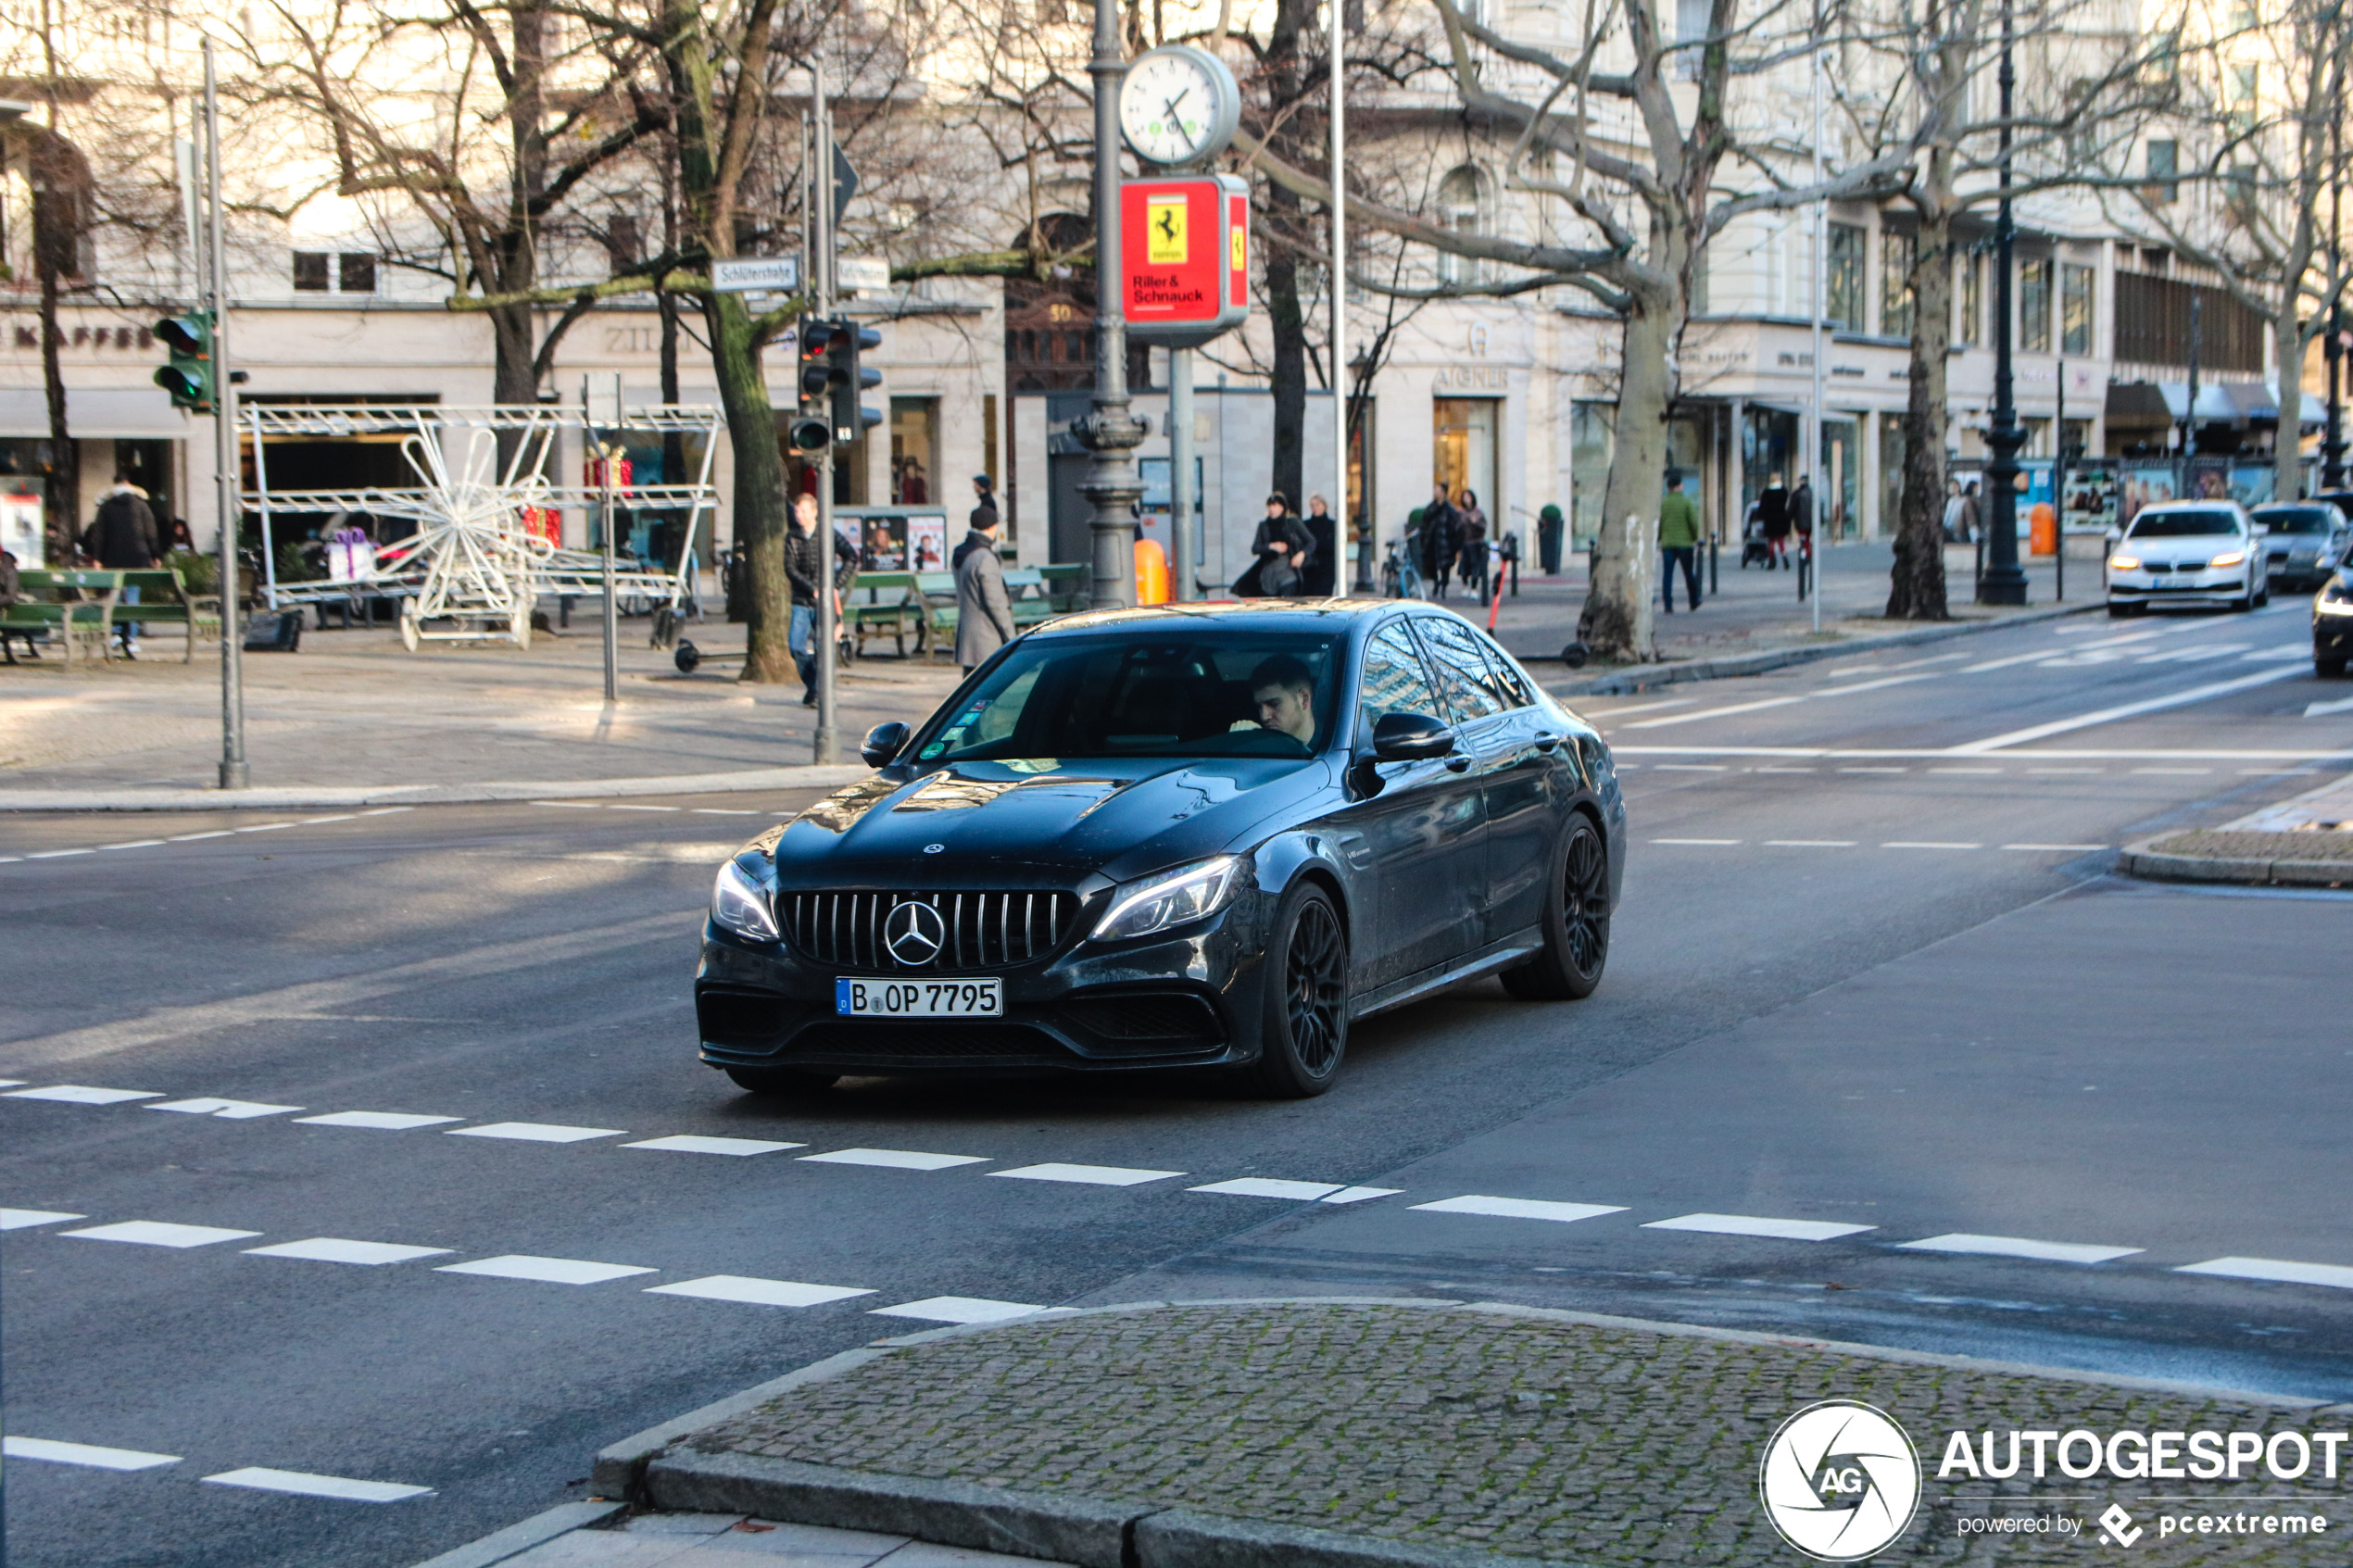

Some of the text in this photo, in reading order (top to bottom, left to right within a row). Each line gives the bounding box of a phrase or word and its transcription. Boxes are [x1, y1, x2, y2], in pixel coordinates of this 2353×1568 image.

[1133, 275, 1178, 287] Riller &
[1134, 289, 1202, 303] Schnauck
[1437, 367, 1509, 388] AIGNER
[852, 984, 867, 1011] B
[886, 985, 919, 1012] OP
[926, 985, 996, 1012] 7795
